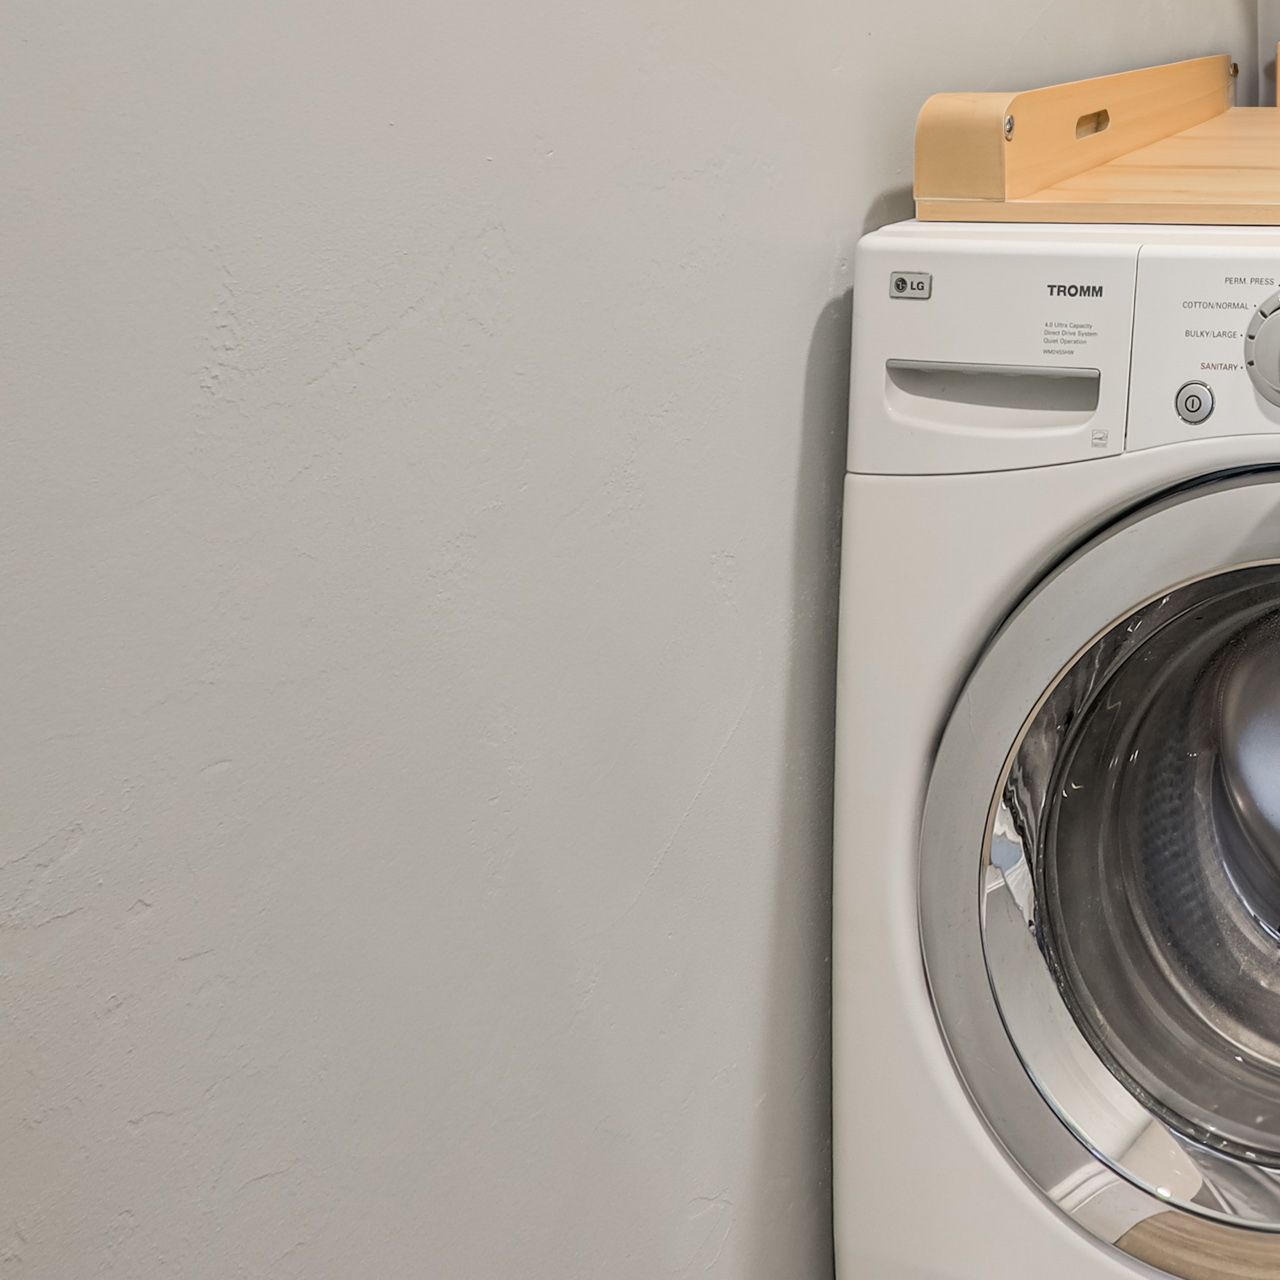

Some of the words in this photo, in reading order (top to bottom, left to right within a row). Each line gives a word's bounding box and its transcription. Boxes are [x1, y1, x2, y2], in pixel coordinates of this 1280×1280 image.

[910, 281, 925, 291] LG
[1249, 278, 1275, 286] PRESS
[1047, 284, 1103, 298] TROMM
[1182, 301, 1249, 310] COTTON/NORMAL
[1184, 330, 1237, 339] BULKY/LARGE
[1200, 362, 1238, 371] SANITARY
